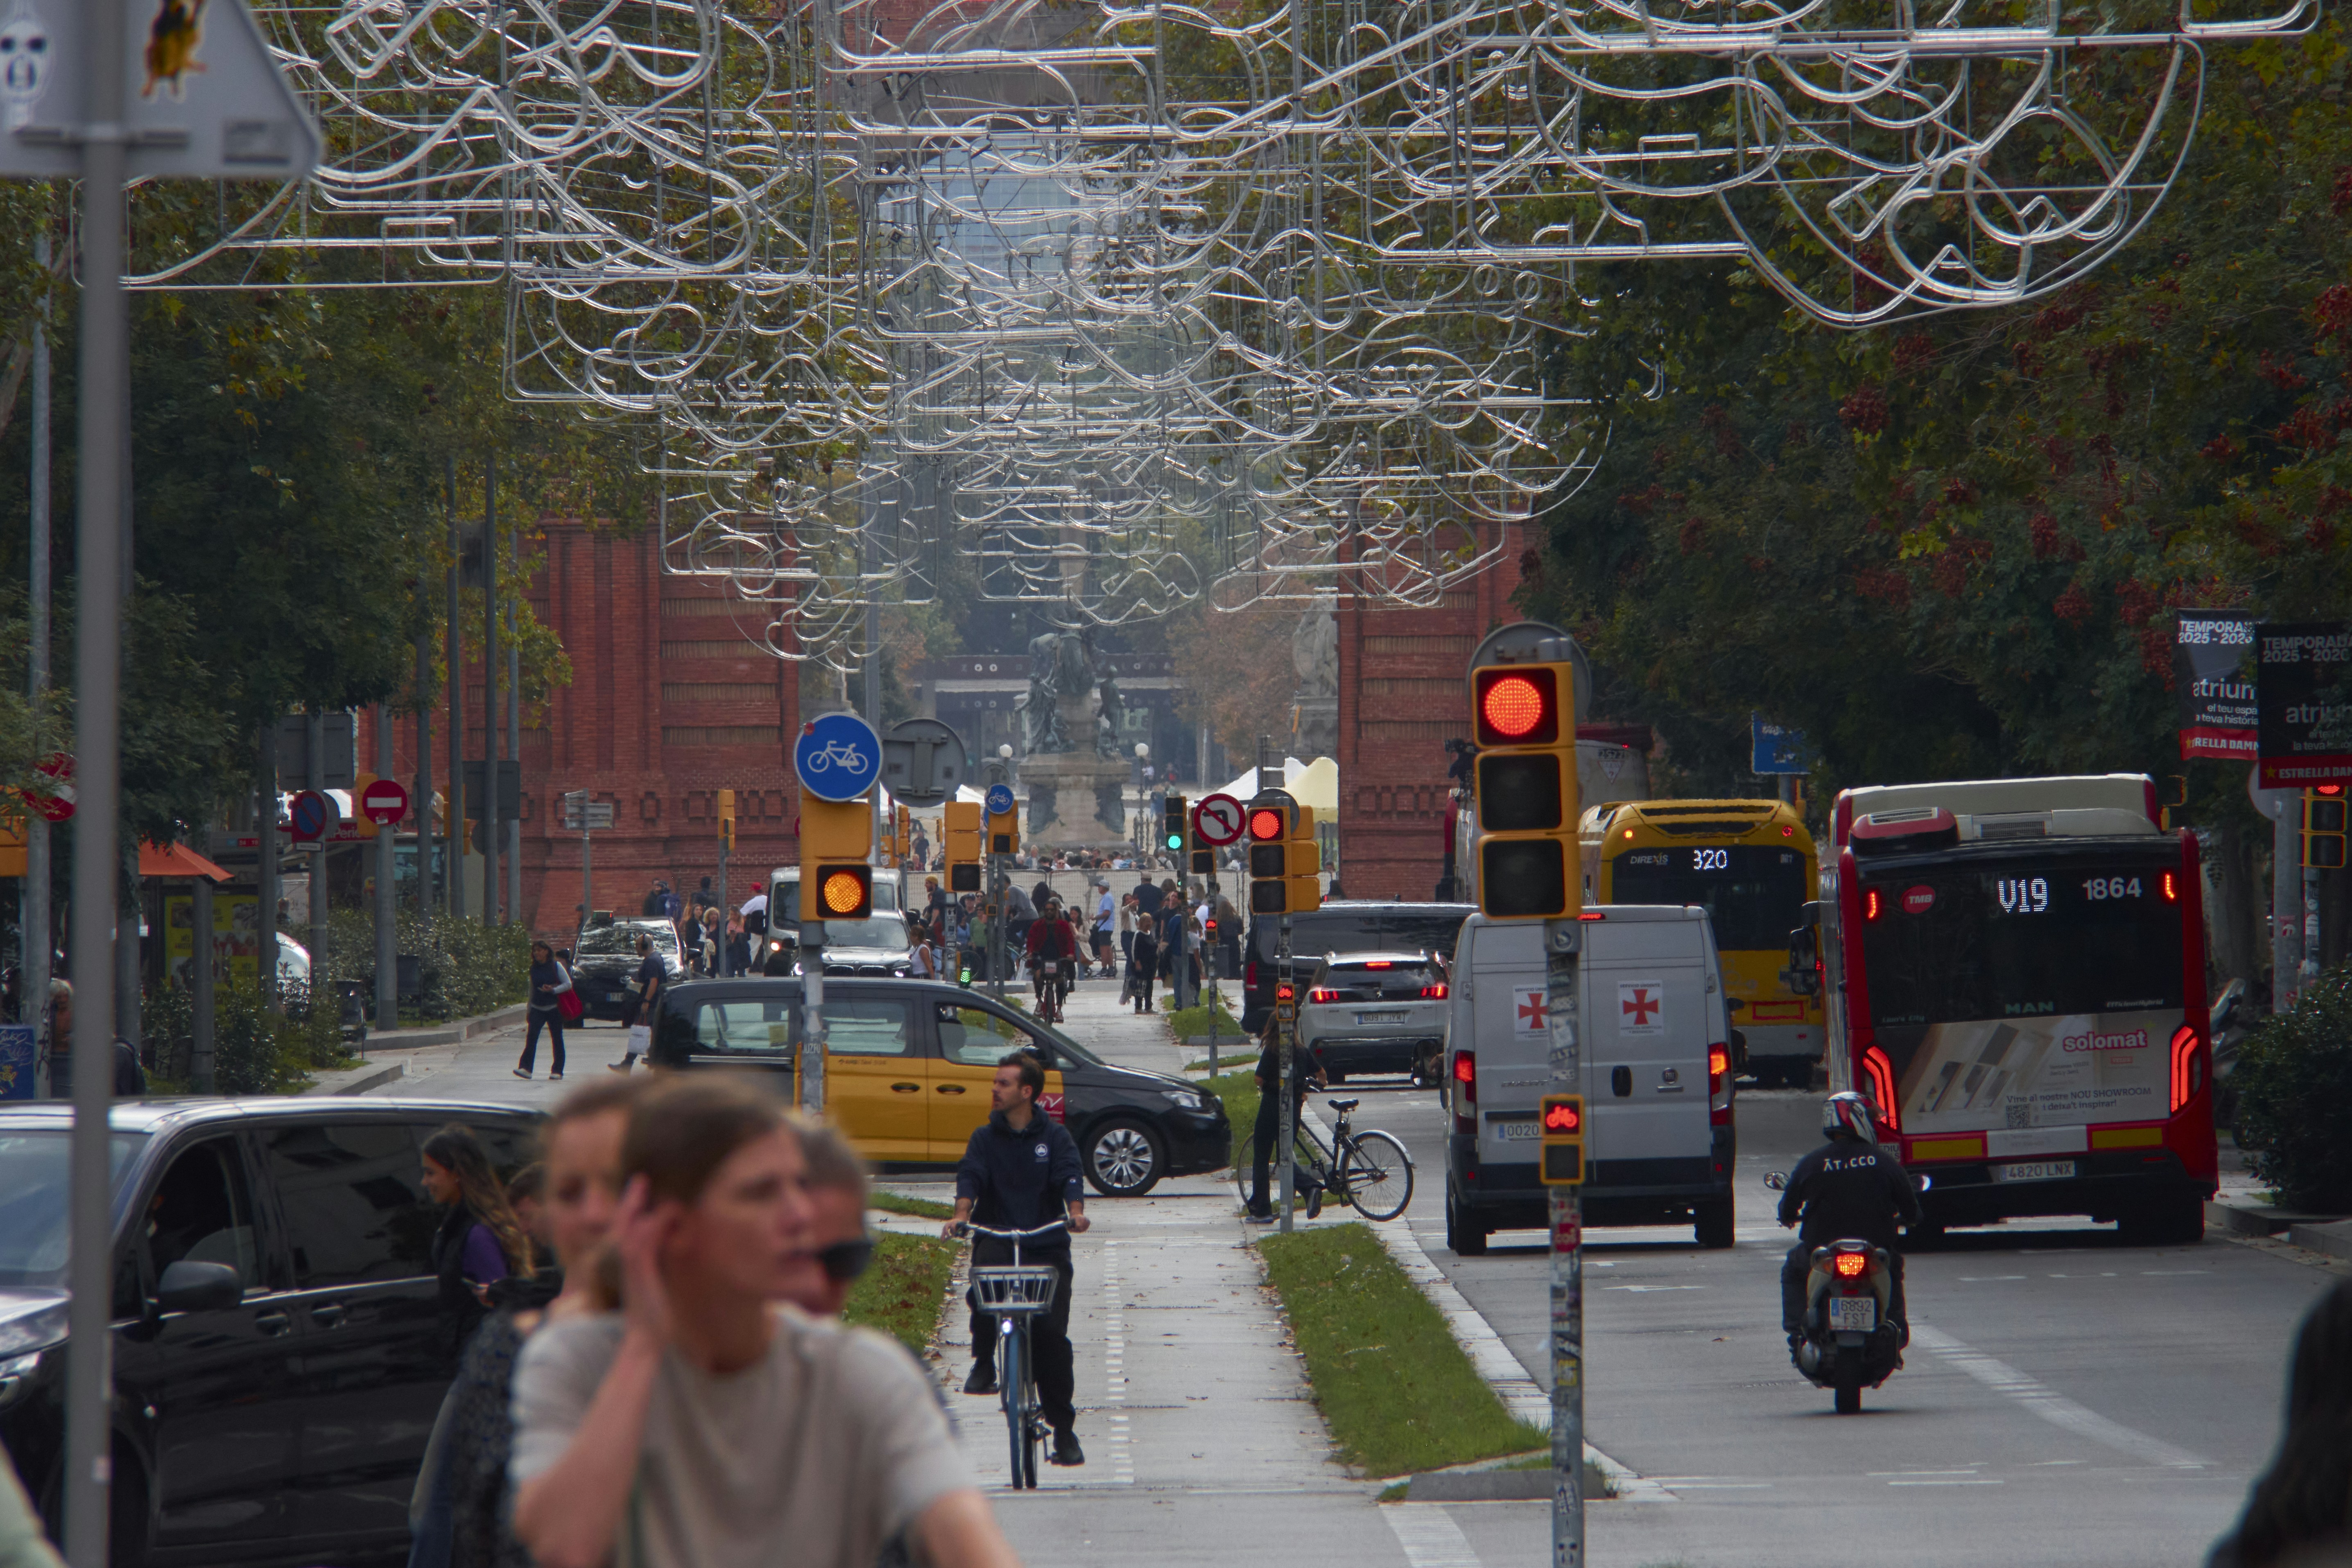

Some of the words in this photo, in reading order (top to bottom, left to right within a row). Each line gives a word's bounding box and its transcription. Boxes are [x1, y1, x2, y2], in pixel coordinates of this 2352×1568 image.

[2178, 632, 2210, 644] 2025
[2262, 649, 2300, 663] 2025
[2218, 705, 2233, 713] teu
[2202, 714, 2223, 723] teva
[2279, 767, 2331, 778] ESTRELLA
[1693, 849, 1728, 870] 320
[2082, 877, 2142, 900] 1864
[1909, 894, 1932, 904] TMB
[2005, 1000, 2055, 1014] MAN
[2064, 1030, 2146, 1051] solomat
[2070, 1091, 2091, 1099] NOU
[2093, 1087, 2151, 1098] SHOWROOM
[1508, 1125, 1539, 1136] 0020
[2009, 1165, 2042, 1178] 4820
[2047, 1163, 2071, 1176] LNX
[1841, 1300, 1871, 1312] 6892
[1844, 1313, 1866, 1324] FST
